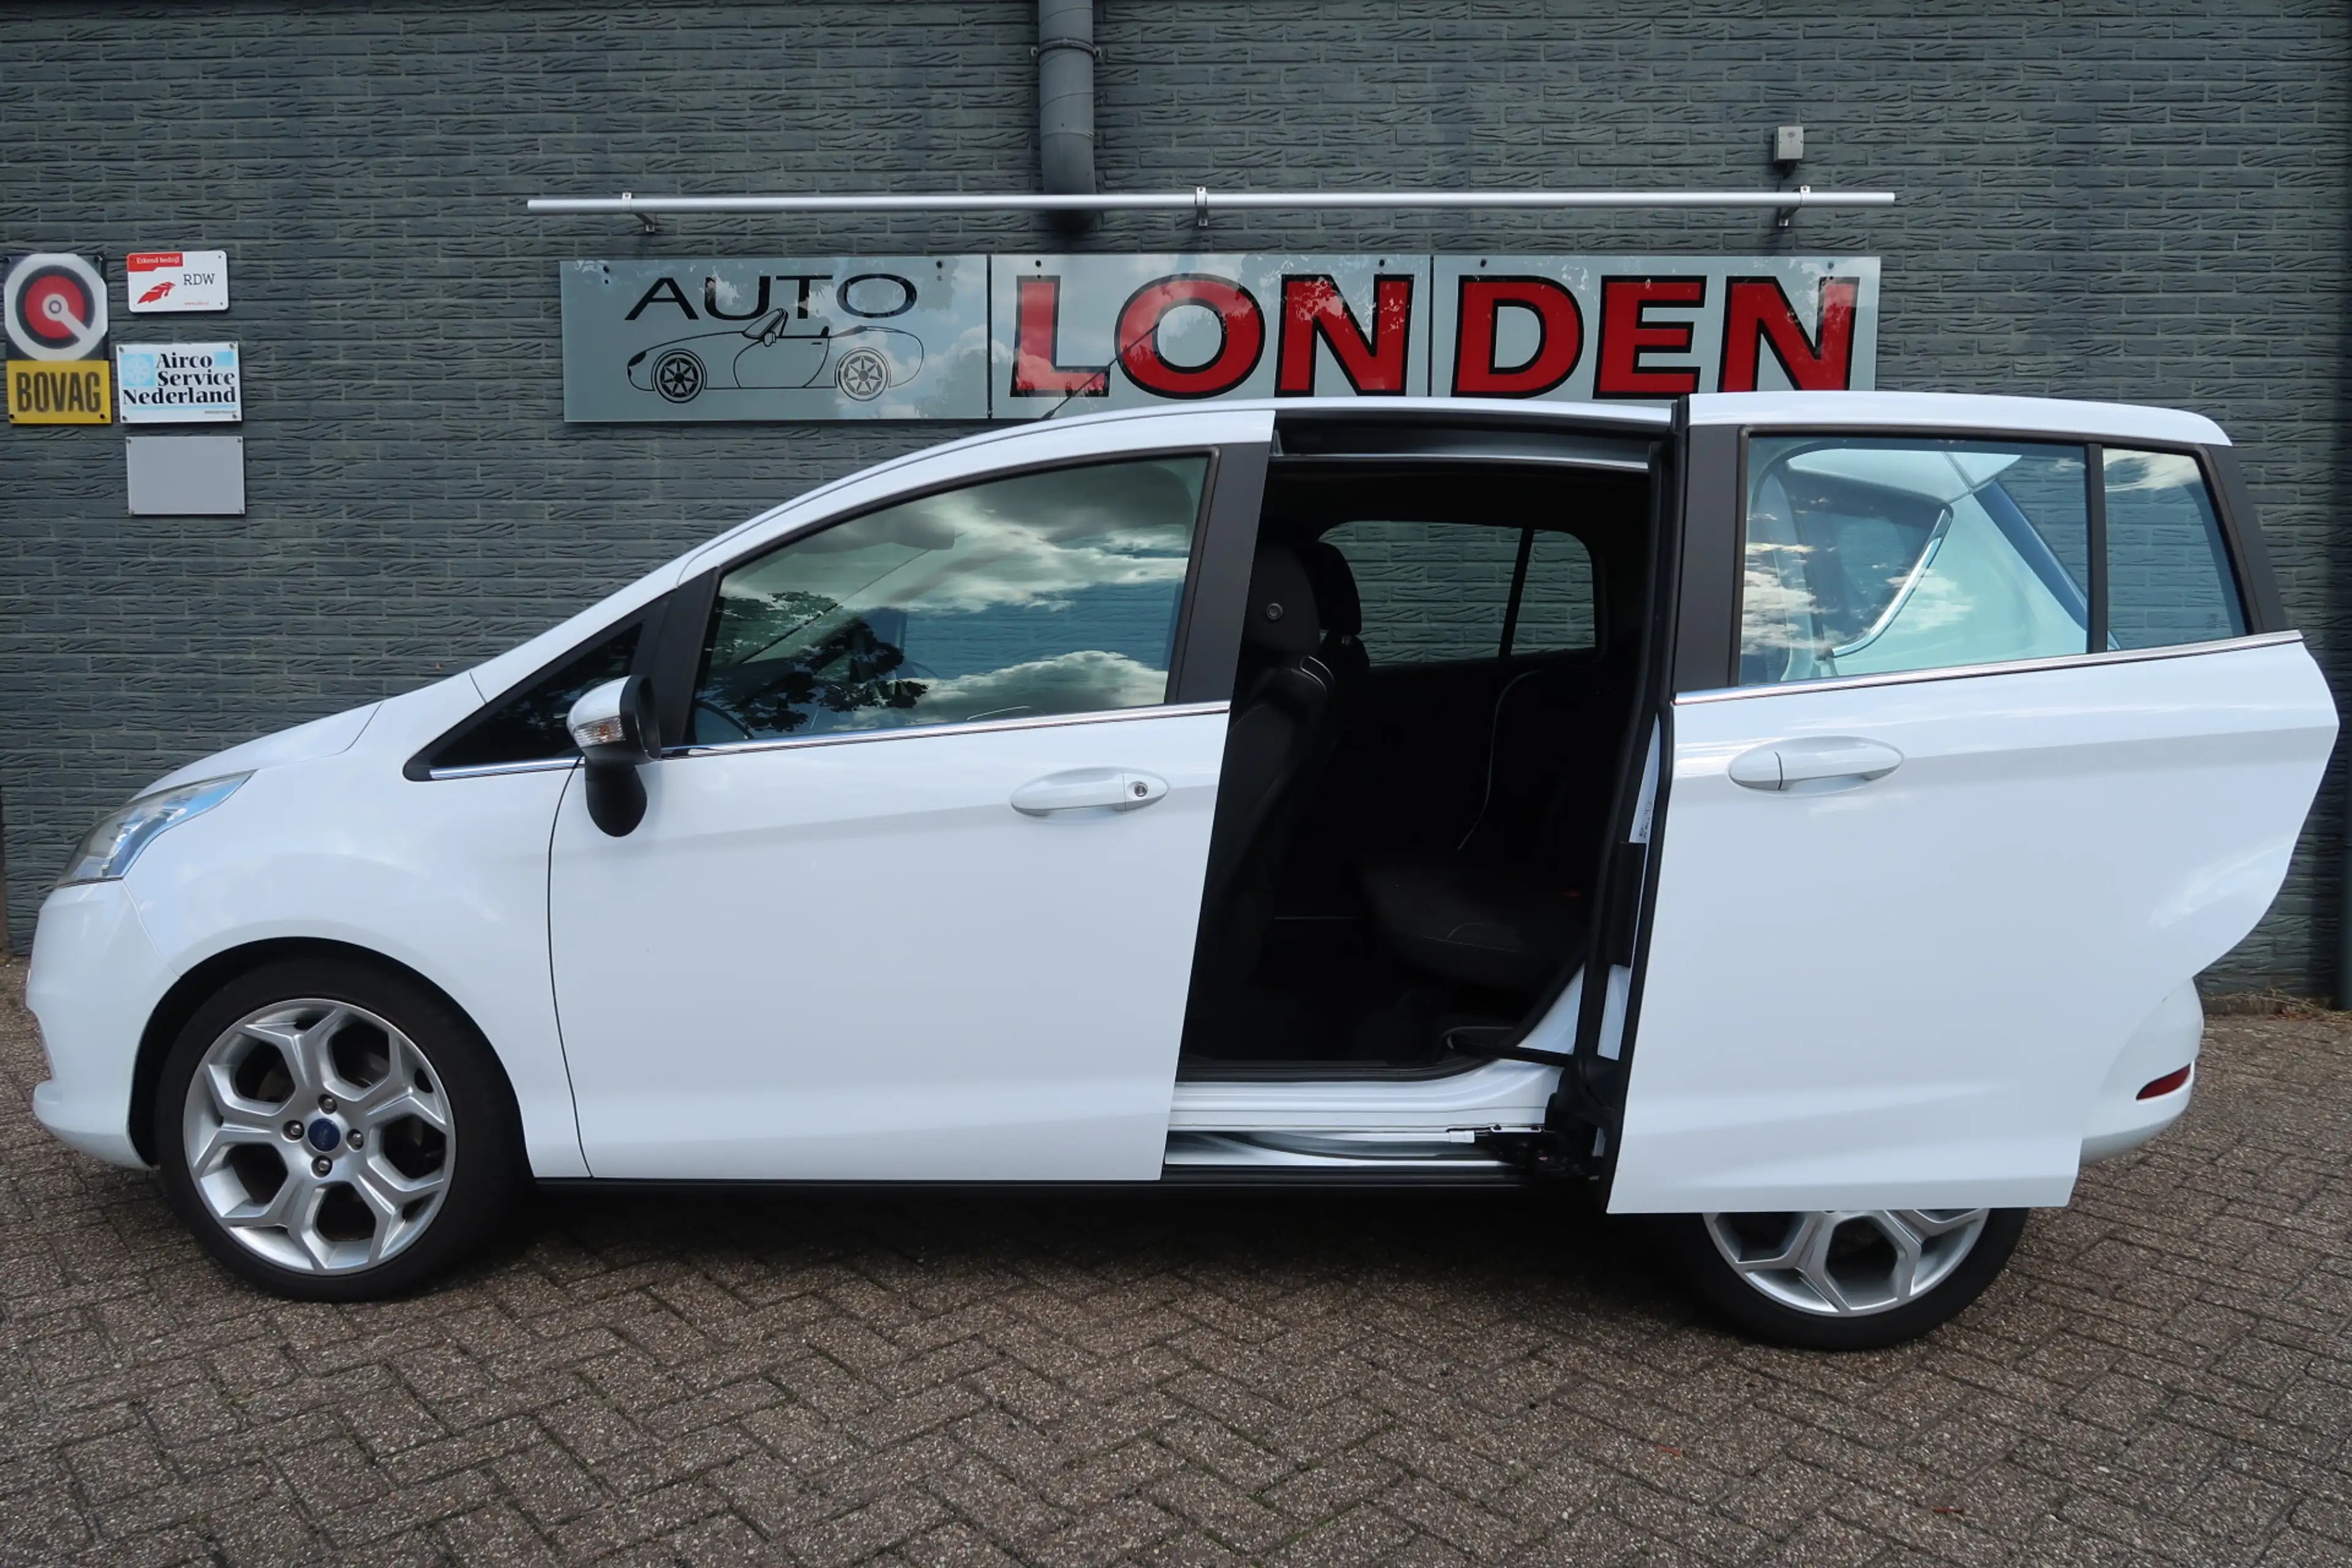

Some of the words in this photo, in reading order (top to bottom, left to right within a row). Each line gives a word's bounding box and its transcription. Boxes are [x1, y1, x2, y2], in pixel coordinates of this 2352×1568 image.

[183, 273, 215, 285] RDW
[624, 273, 918, 321] AUTO
[1009, 273, 1860, 401] LONDEN
[156, 352, 213, 369] Airco
[157, 369, 236, 386] Service
[16, 371, 101, 413] BOVAG
[123, 386, 237, 405] Nederland
